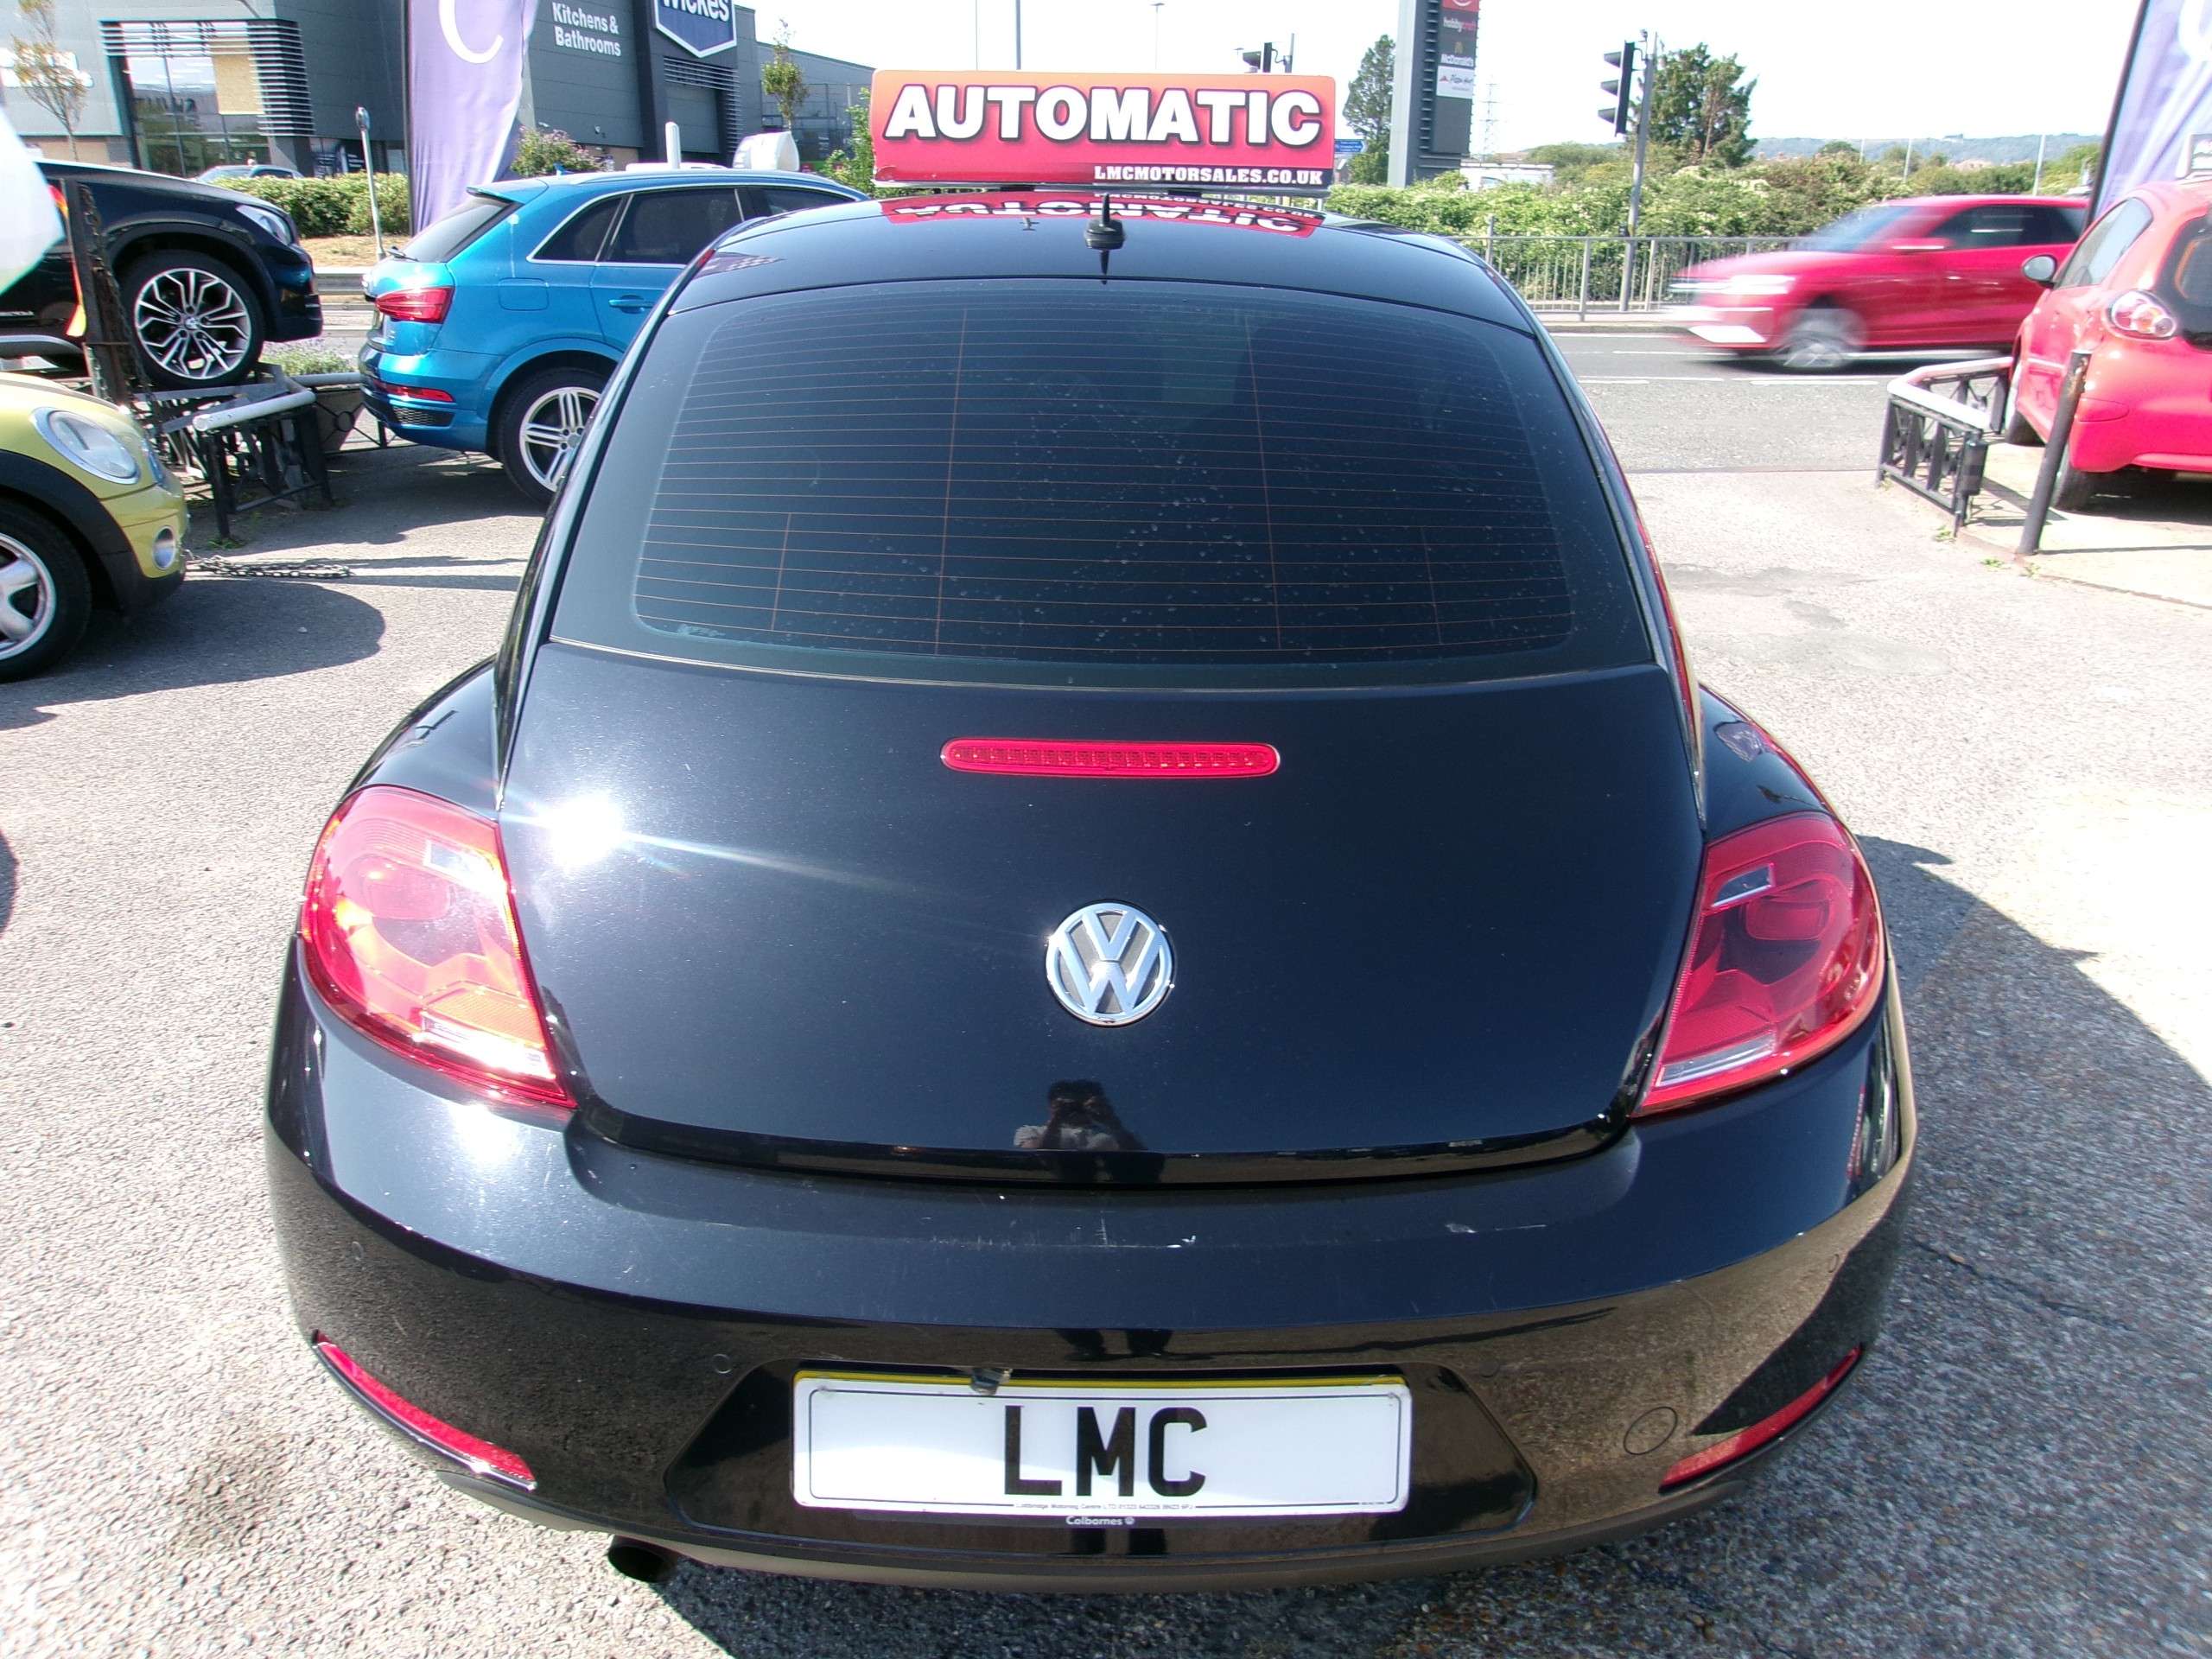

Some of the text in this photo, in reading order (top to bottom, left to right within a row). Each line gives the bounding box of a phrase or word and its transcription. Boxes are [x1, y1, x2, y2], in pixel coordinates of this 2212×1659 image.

[552, 2, 620, 35] Kitchens &
[663, 0, 729, 22] ckes
[554, 25, 621, 56] Bathrooms
[883, 84, 1322, 147] AUTOMATIC
[1094, 165, 1323, 185] LMCMOTORSALES.CO.UK
[1004, 1405, 1207, 1497] LMC
[1065, 1516, 1123, 1526] Colbornes
